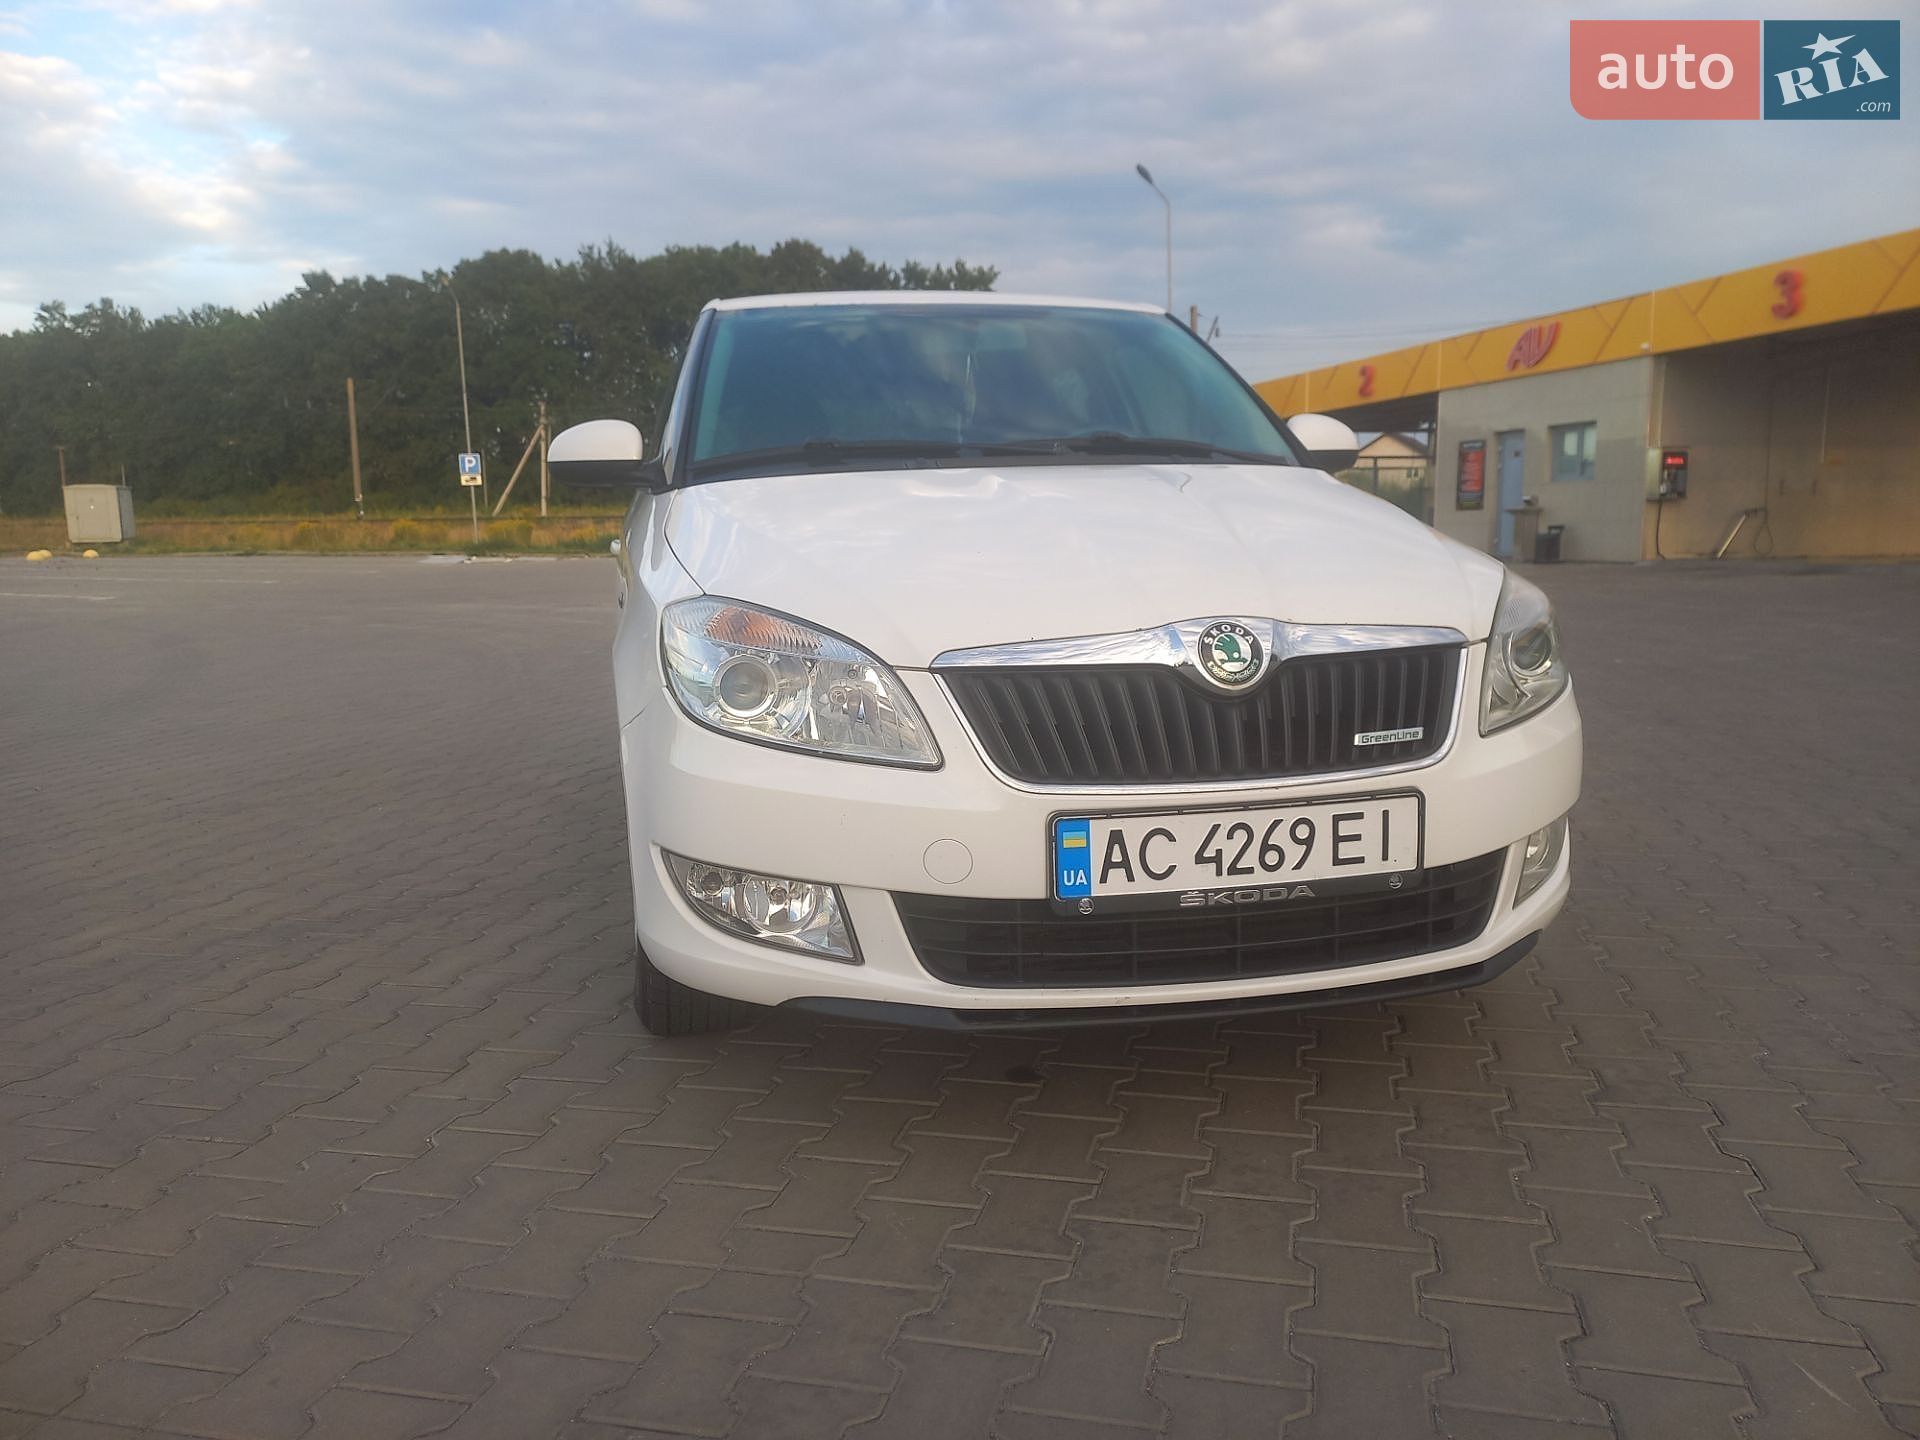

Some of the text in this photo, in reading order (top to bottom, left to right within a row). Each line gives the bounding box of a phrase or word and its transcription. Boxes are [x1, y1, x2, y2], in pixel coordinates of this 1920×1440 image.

[1772, 270, 1804, 319] 3
[1358, 365, 1376, 398] 2
[465, 457, 476, 473] P
[1361, 731, 1420, 744] GreenLine
[1099, 809, 1390, 884] AC 4269 EI
[1063, 869, 1088, 886] UA
[1180, 885, 1316, 906] ŠKODA
